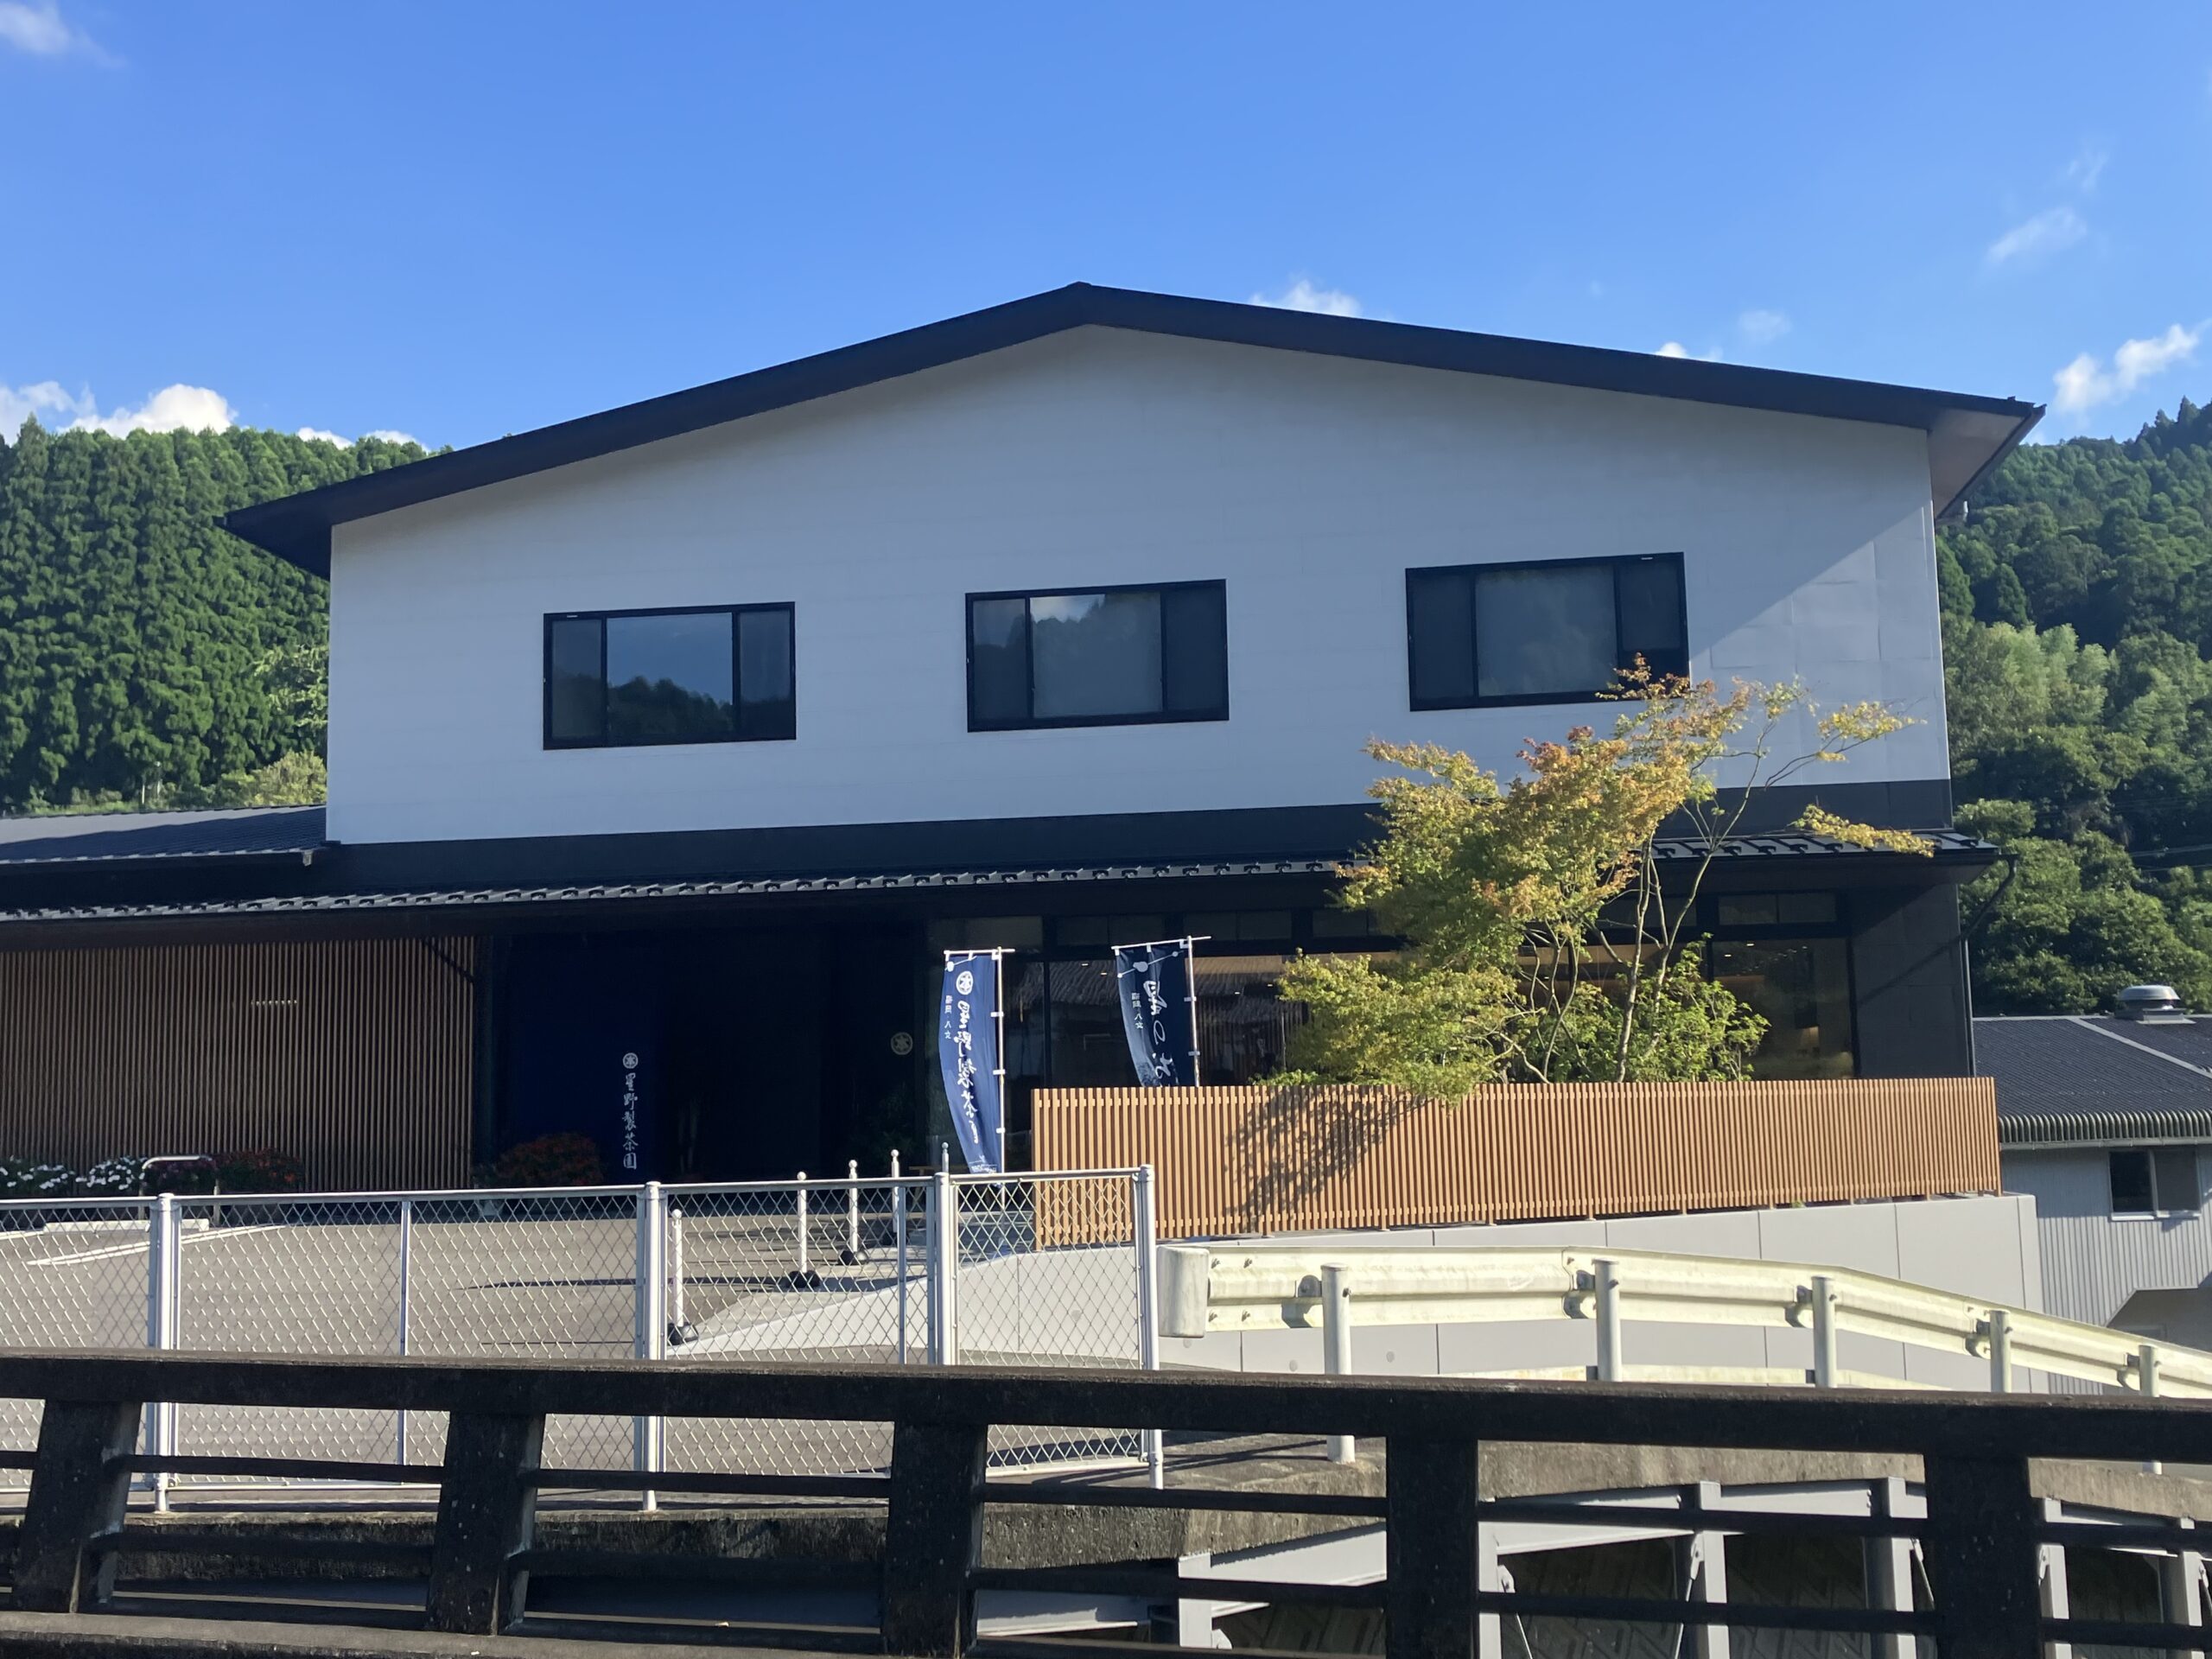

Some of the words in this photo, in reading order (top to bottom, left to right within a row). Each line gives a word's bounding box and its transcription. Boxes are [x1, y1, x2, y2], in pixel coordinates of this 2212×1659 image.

[622, 1072, 639, 1170] 星野製茶園
